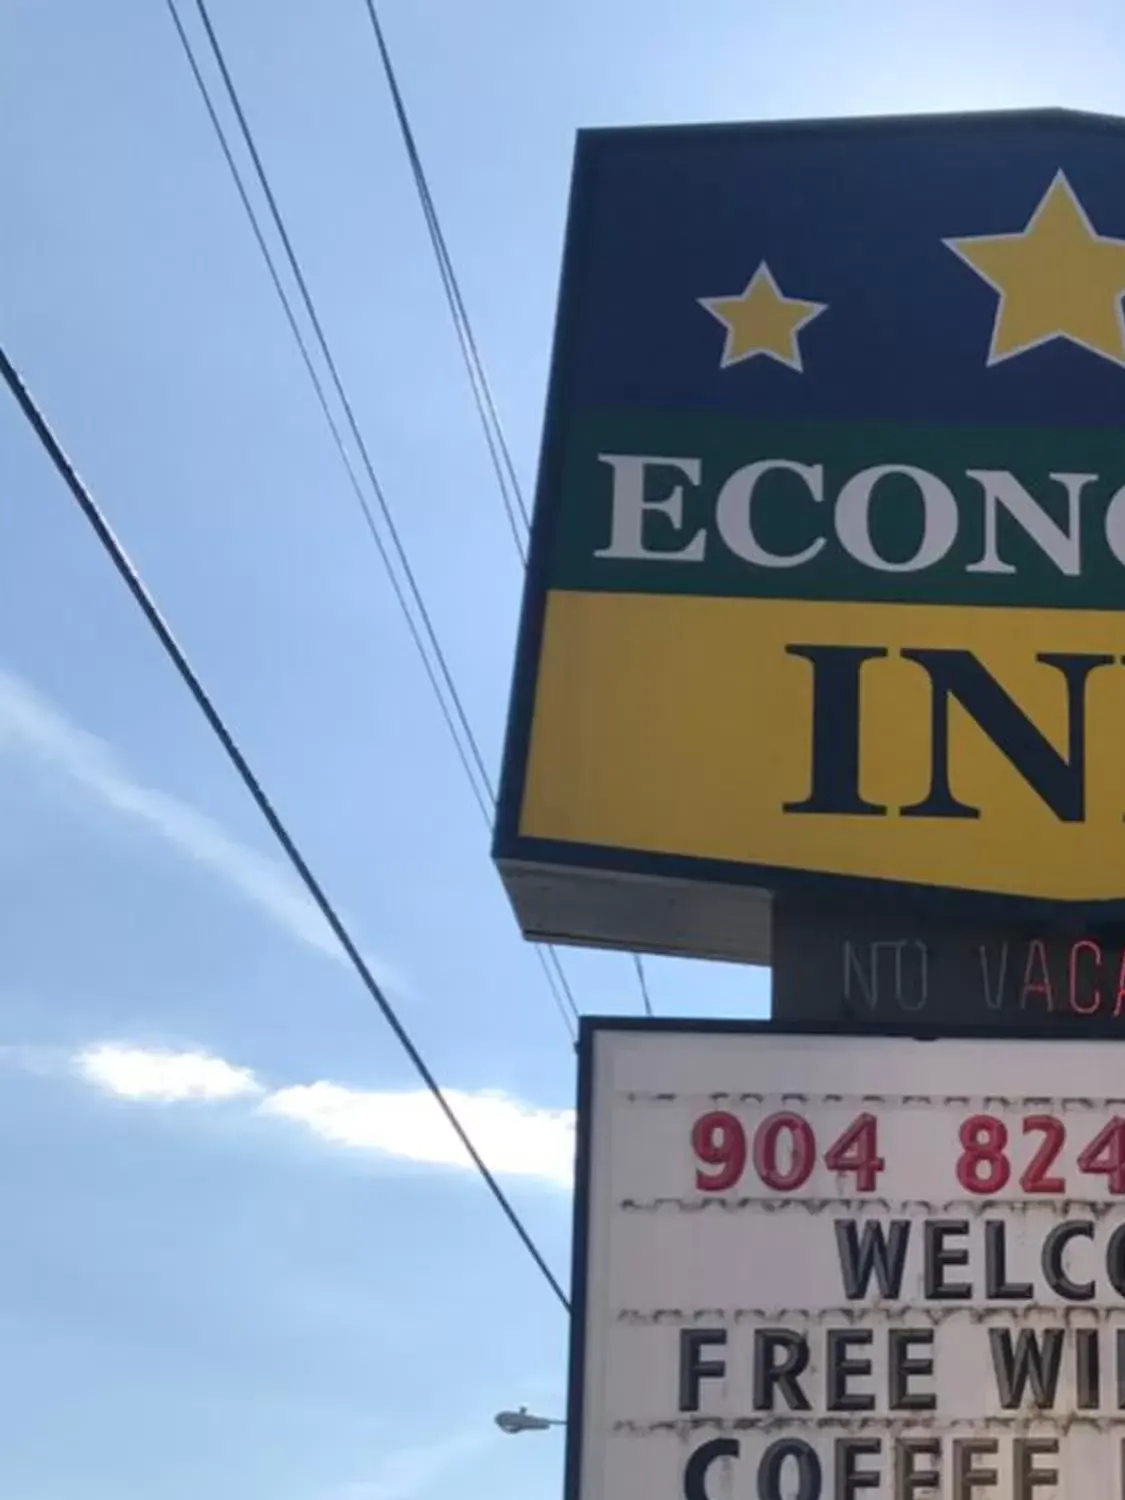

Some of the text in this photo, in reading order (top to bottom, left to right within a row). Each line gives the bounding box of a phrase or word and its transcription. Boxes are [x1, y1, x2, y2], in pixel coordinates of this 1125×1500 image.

[843, 939, 928, 1011] NO
[691, 1110, 885, 1195] 904
[678, 1326, 938, 1413] FREE
